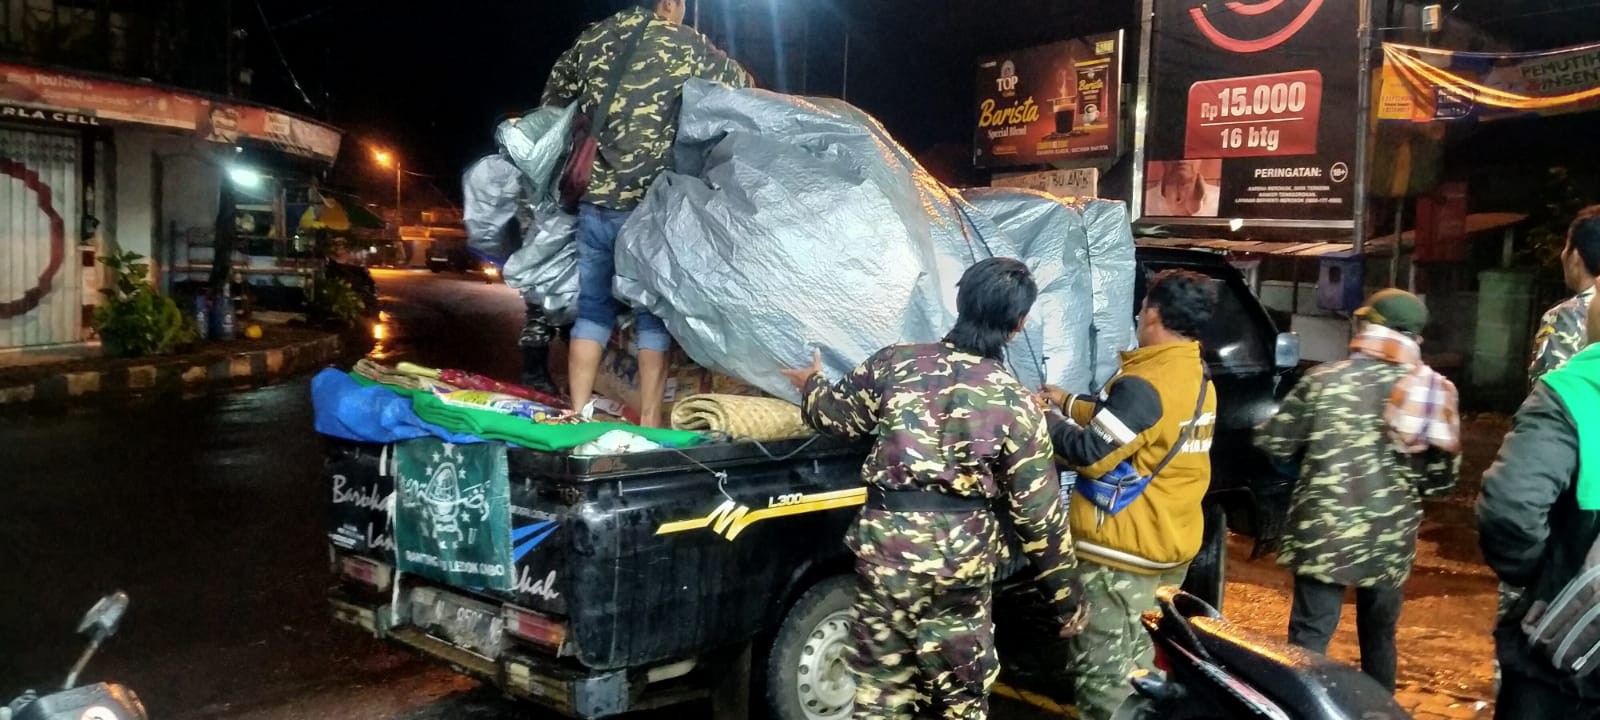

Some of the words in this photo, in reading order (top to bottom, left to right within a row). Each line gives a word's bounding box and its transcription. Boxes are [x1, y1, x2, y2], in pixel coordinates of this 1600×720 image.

[996, 76, 1018, 91] TOP
[1541, 66, 1600, 90] INSEN
[1201, 103, 1218, 121] Rp
[1218, 82, 1306, 117] 15.000
[52, 113, 99, 125] CELL
[978, 96, 1039, 127] Barista
[1221, 128, 1242, 149] 16
[1247, 127, 1280, 151] btg
[1254, 167, 1322, 178] PERINGATAN:
[768, 493, 802, 508] L300
